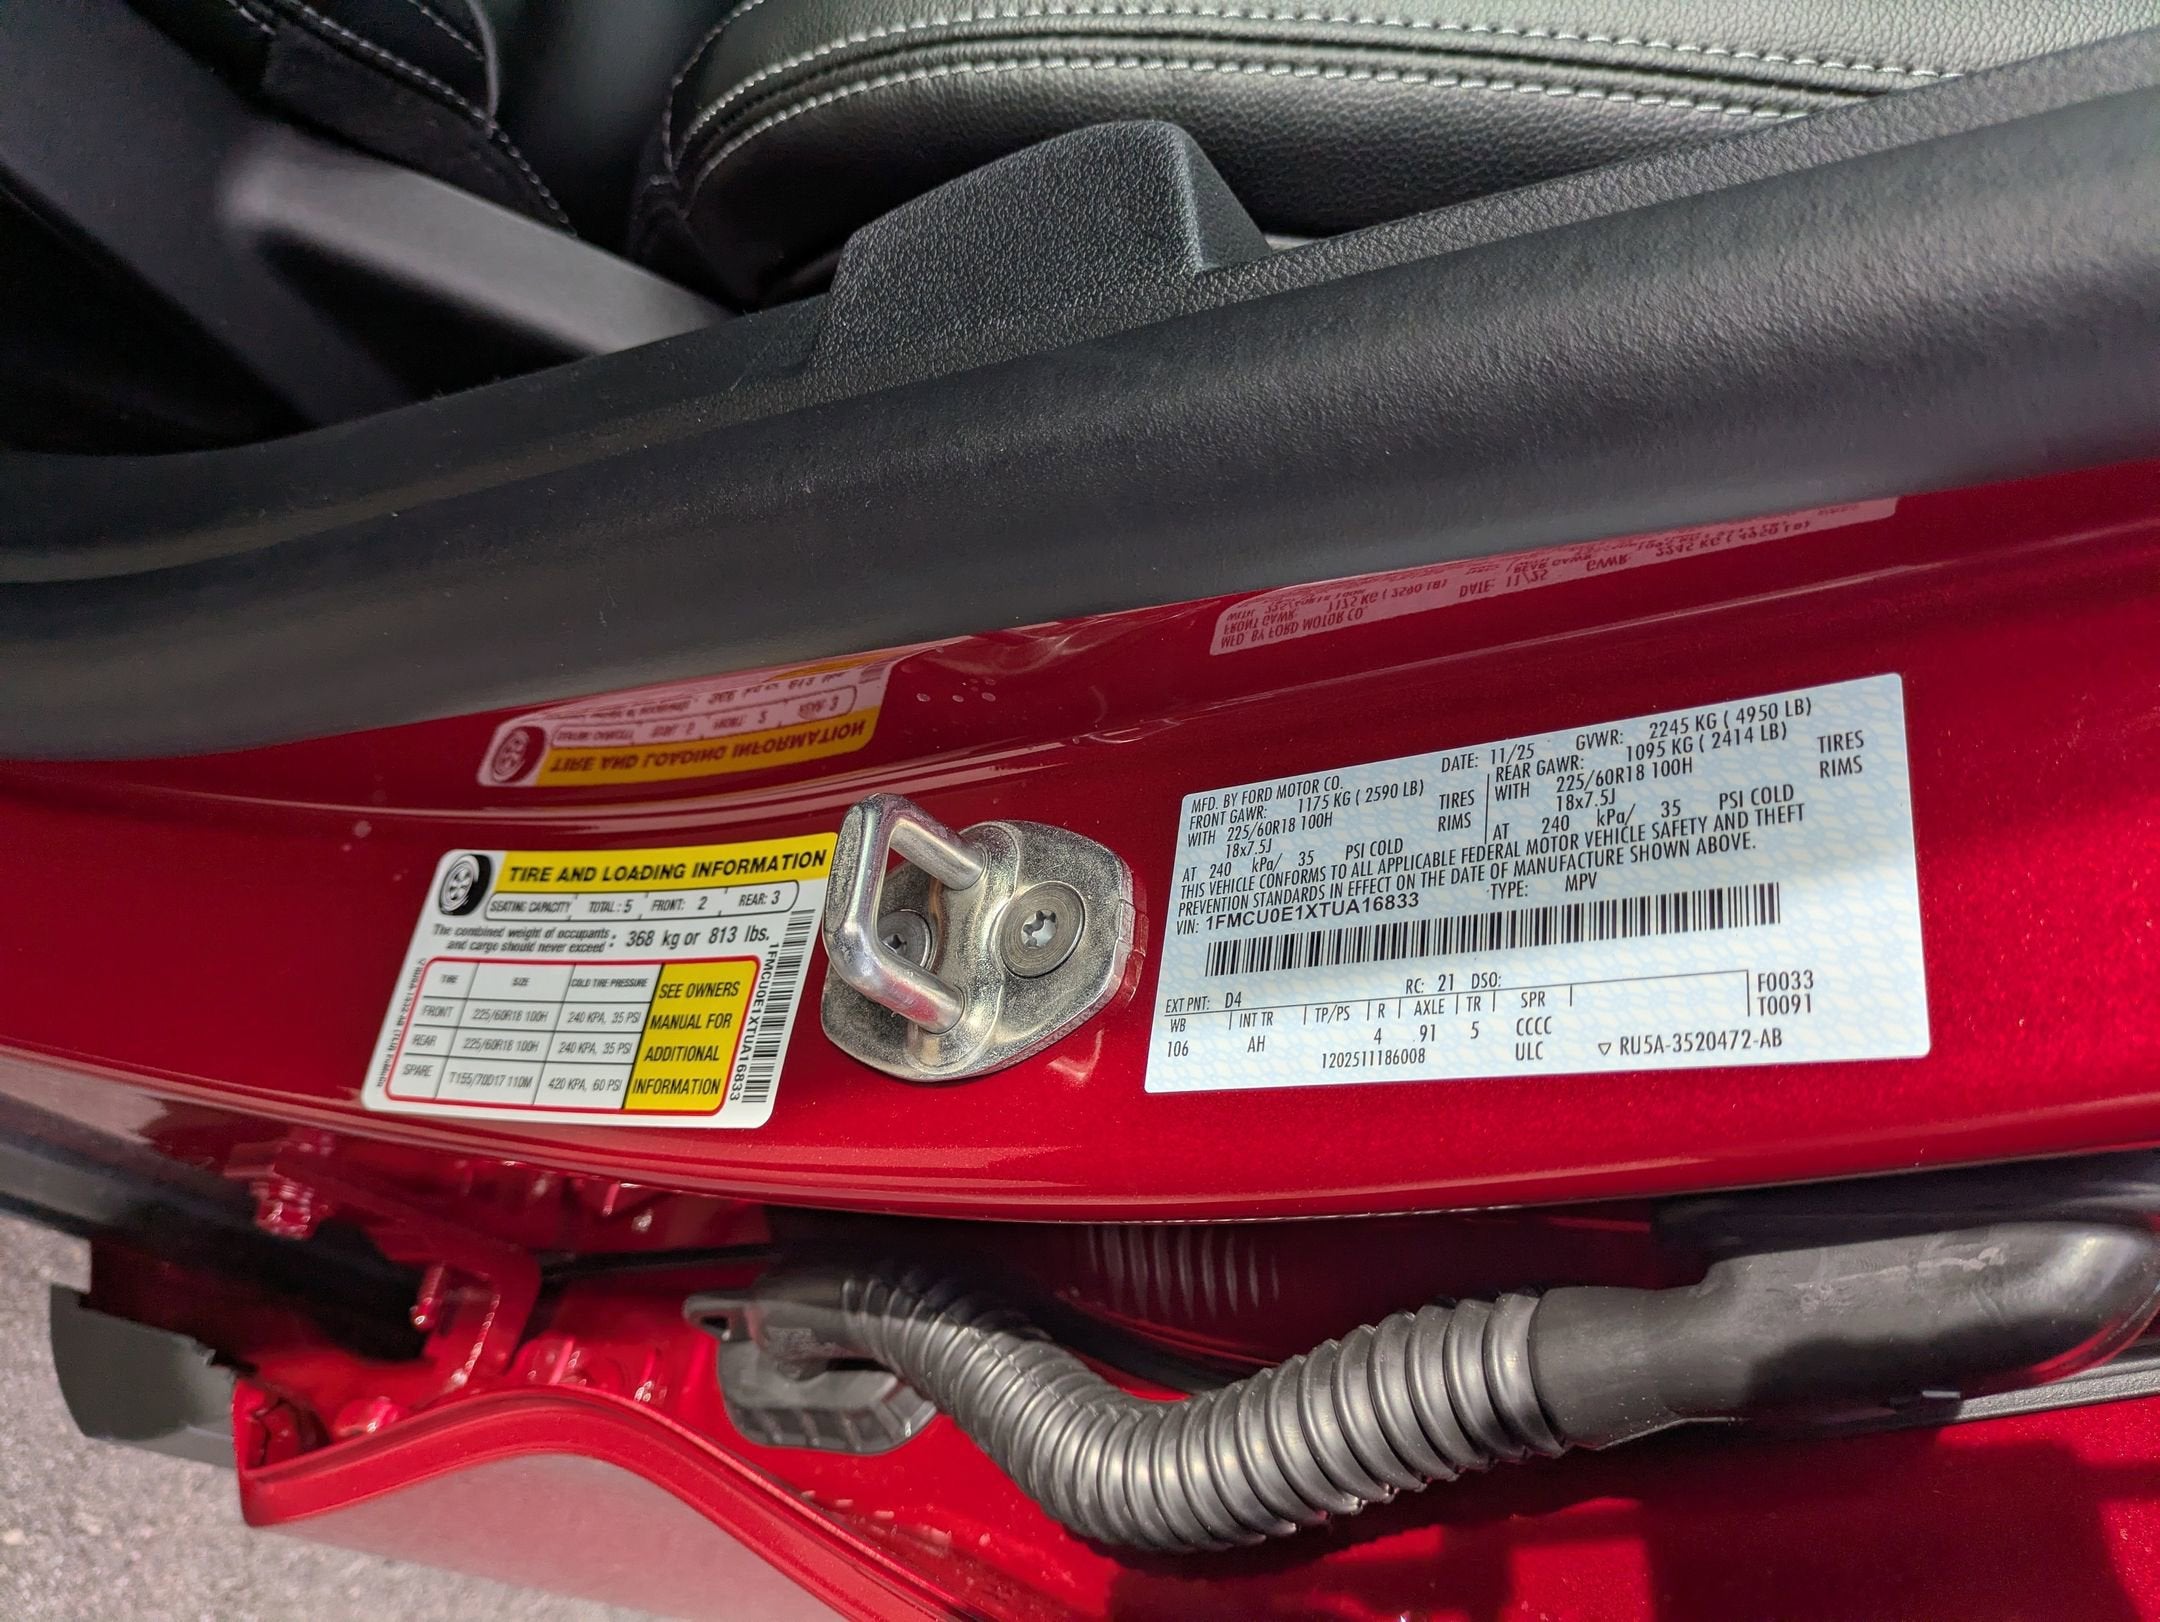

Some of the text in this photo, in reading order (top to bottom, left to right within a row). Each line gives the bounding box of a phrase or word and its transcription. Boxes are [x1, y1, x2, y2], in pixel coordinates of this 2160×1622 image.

[1441, 696, 1812, 774] DATE: 11/25 GVWR: 2245 KG 4950 LB)
[1495, 720, 1787, 783] REAR GAWR: 1095 KG 2414 LB)
[1494, 729, 1865, 802] WITH 225/60R18 100H TIRES
[1556, 754, 1863, 813] 18x7.5J RIMS
[1189, 778, 1424, 831] FRONT GAWR: 1175 KG 2590 LB)
[1190, 774, 1344, 814] MFD. BY FORD MOTOR CO.
[1187, 788, 1475, 848] WITH 225/60R18 100H TIRES
[1226, 811, 1472, 859] 18x7.5J RIMS
[1492, 822, 1510, 842] AT
[1541, 814, 1570, 835] 240
[1596, 803, 1636, 827] kPa/
[1660, 798, 1681, 819] 35
[1719, 790, 1744, 811] PSI
[509, 848, 828, 883] TIRE AND LOADING INFORMATION
[1180, 802, 1805, 900] THIS VEHICLE CONFORMS TO ALL APPLICABLE FEDERAL MOTOR VEHICLE SAFETY AND THEFT
[1181, 866, 1198, 883] AT
[1208, 861, 1232, 880] 240
[1251, 852, 1283, 874] kPa/
[1297, 849, 1315, 867] 35
[1345, 842, 1365, 861] PSI
[1177, 831, 1756, 918] PREVENTION STANDARDS IN EFFECT ON THE DATE OF MANUFACTURE SHOWN ABOVE.
[622, 898, 634, 914] 5
[650, 897, 686, 912] FRONT:
[697, 895, 708, 911] 2
[738, 892, 768, 907] REAR:
[770, 889, 781, 906] 3
[1176, 871, 1598, 936] VIN: 1FMCU0E1XTUA16833 TYPE: MPV
[433, 923, 611, 942] The combined weight of occupants
[445, 940, 468, 951] and
[500, 941, 537, 953] should
[537, 942, 568, 953] never
[568, 941, 607, 953] exceed
[625, 924, 770, 950] 368 kg or 813 lbs.
[658, 980, 741, 999] SEE OWNERS
[1165, 971, 1502, 1014] EXT PNT: D4 RC: 21 DSO:
[1757, 969, 1814, 993] F0033
[421, 1004, 455, 1018] FRONT
[567, 1011, 586, 1024] 240
[610, 1011, 626, 1025] 35
[625, 1011, 642, 1024] PSI
[649, 1012, 733, 1030] MANUAL FOR
[729, 943, 780, 1101] 1FMCU0E1XTUA16833
[1170, 990, 1546, 1033] WB INT TR TP/PS R AXLE TR SPR
[1757, 992, 1811, 1017] T0091
[411, 1033, 438, 1047] REAR
[557, 1041, 577, 1055] 240
[602, 1041, 617, 1055] 35
[616, 1041, 633, 1055] PSI
[643, 1045, 720, 1062] ADDITIONAL
[1167, 1015, 1552, 1058] 106 AH 4 91 5 CCCC
[1322, 1027, 1783, 1069] 1202511186008 ULC RU5A-3520472-AB
[402, 1063, 434, 1078] SPARE
[547, 1077, 567, 1090] 420
[591, 1078, 606, 1092] 60
[606, 1078, 624, 1092] PSI
[632, 1077, 722, 1096] INFORMATION
